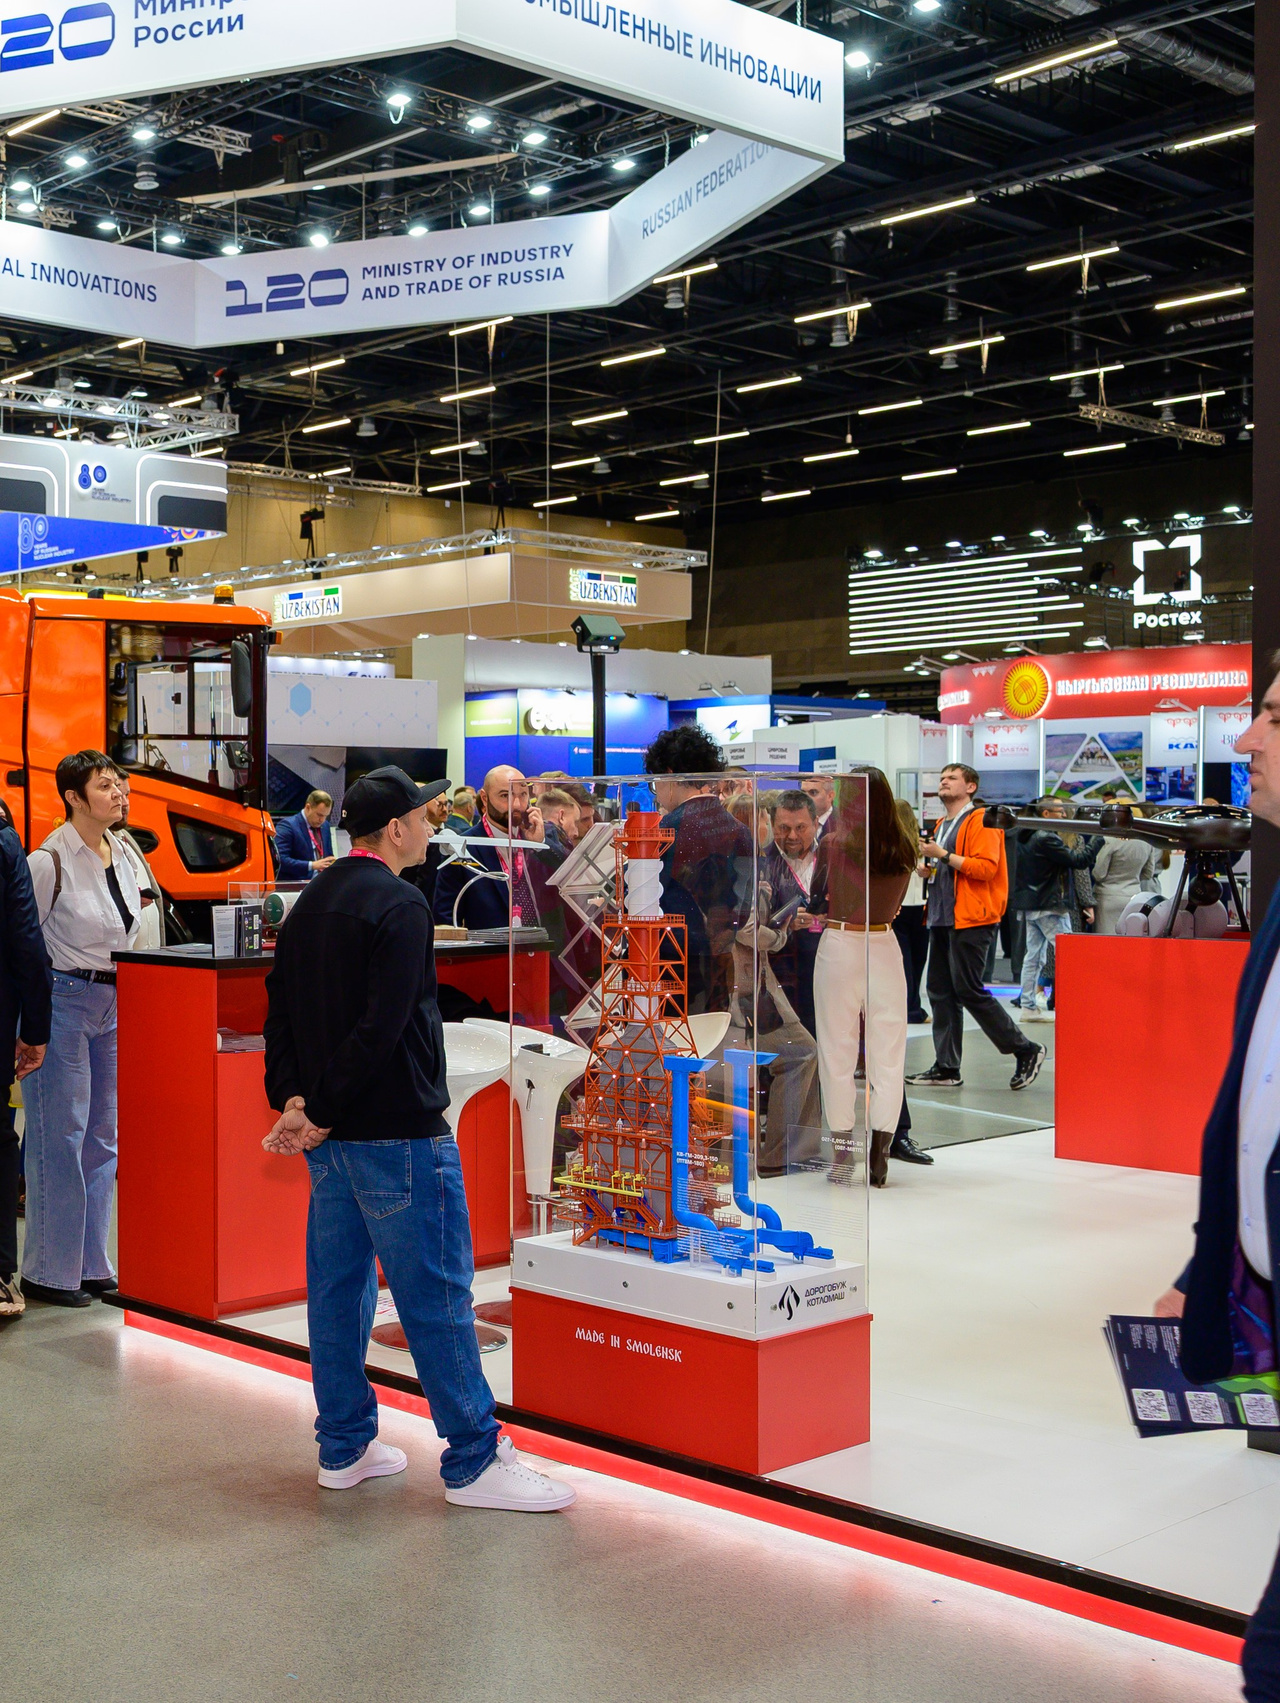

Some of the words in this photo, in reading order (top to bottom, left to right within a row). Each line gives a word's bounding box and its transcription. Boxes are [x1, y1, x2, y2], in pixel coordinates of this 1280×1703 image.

[134, 14, 244, 48] России
[700, 37, 822, 103] ИННОВАЦИИ
[642, 187, 693, 240] RUSSIAN
[362, 257, 447, 280] MINISTRY
[452, 254, 476, 270] OF
[480, 243, 574, 268] INDUSTRY
[30, 262, 158, 303] INNOVATIONS
[225, 268, 349, 317] 120
[362, 284, 400, 301] AND
[405, 278, 464, 297] TRADE
[468, 274, 492, 290] OF
[498, 265, 566, 287] RUSSIA
[281, 597, 340, 620] UZBEKISTAN
[580, 581, 637, 604] UZBEKISTAN
[1133, 610, 1202, 629] Ростех
[1151, 670, 1249, 690] РЕСПУБЛИКА
[805, 1281, 847, 1298] ДОРОГОБУЖ
[807, 1291, 845, 1307] КОТЛОМАШ
[575, 1327, 605, 1345] MADE
[610, 1334, 621, 1348] IN
[626, 1338, 683, 1363] SMOLENSK
